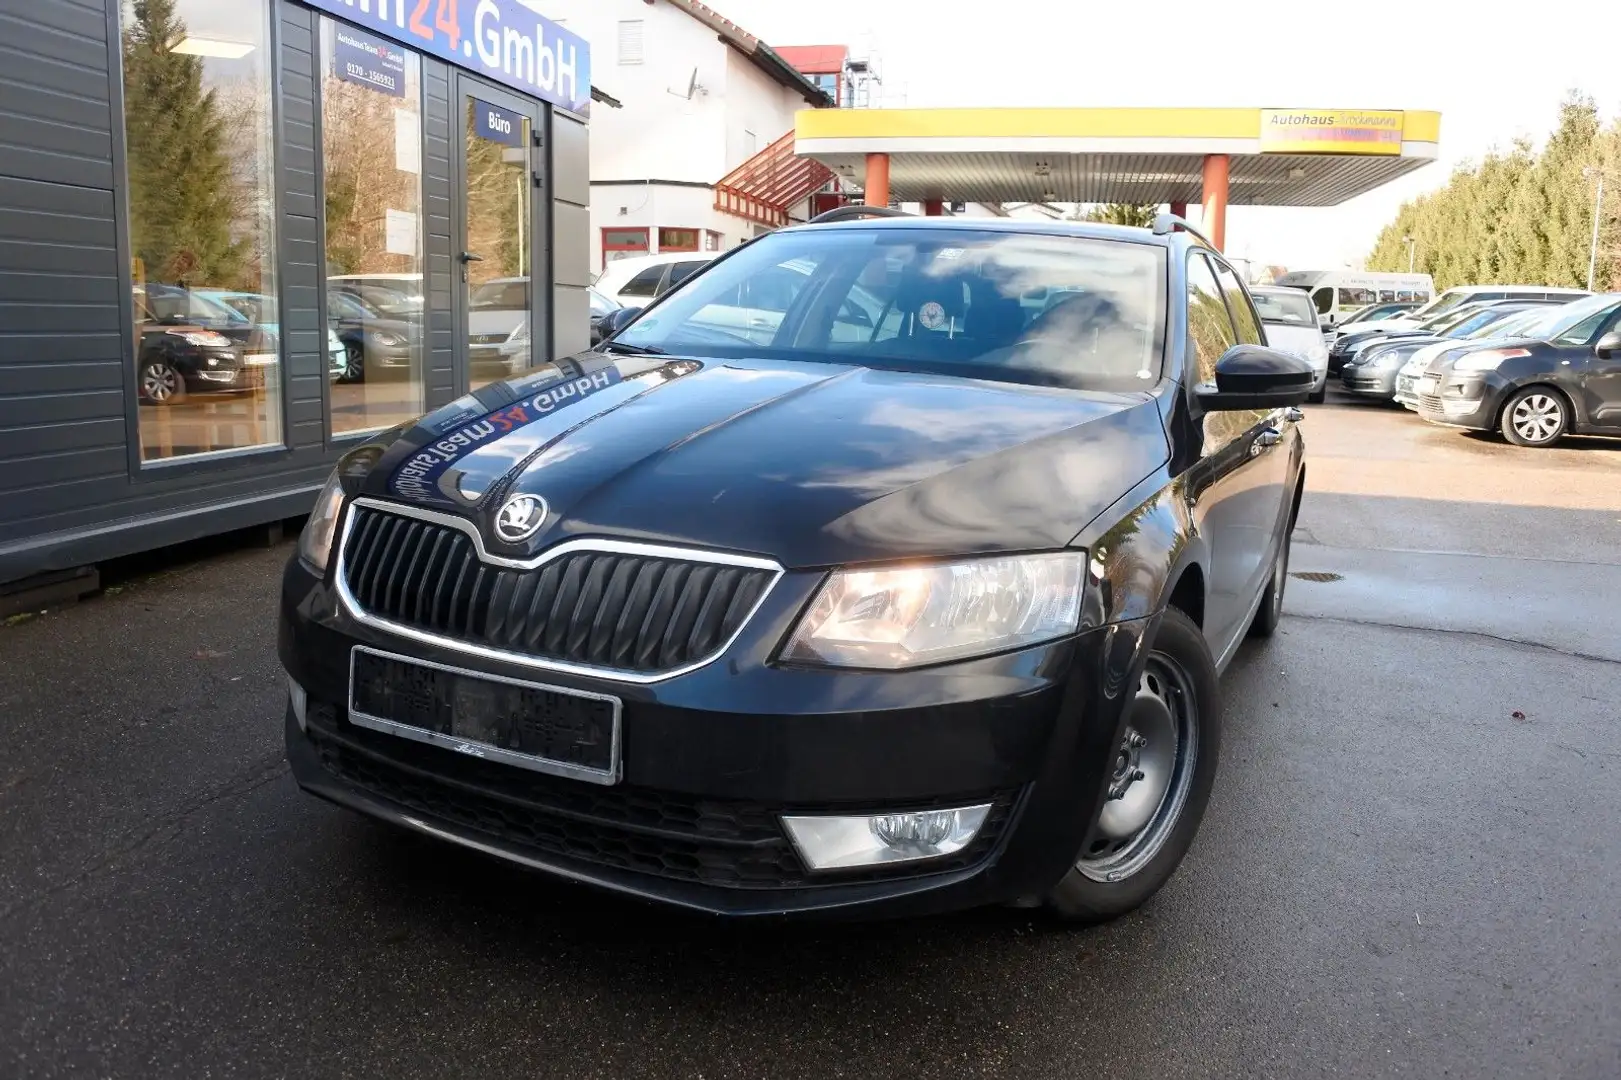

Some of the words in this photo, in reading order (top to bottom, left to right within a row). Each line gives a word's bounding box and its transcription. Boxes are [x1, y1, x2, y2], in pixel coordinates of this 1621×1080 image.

[347, 62, 363, 76] 0170
[488, 111, 511, 134] Büro
[1270, 113, 1334, 125] Autohaus
